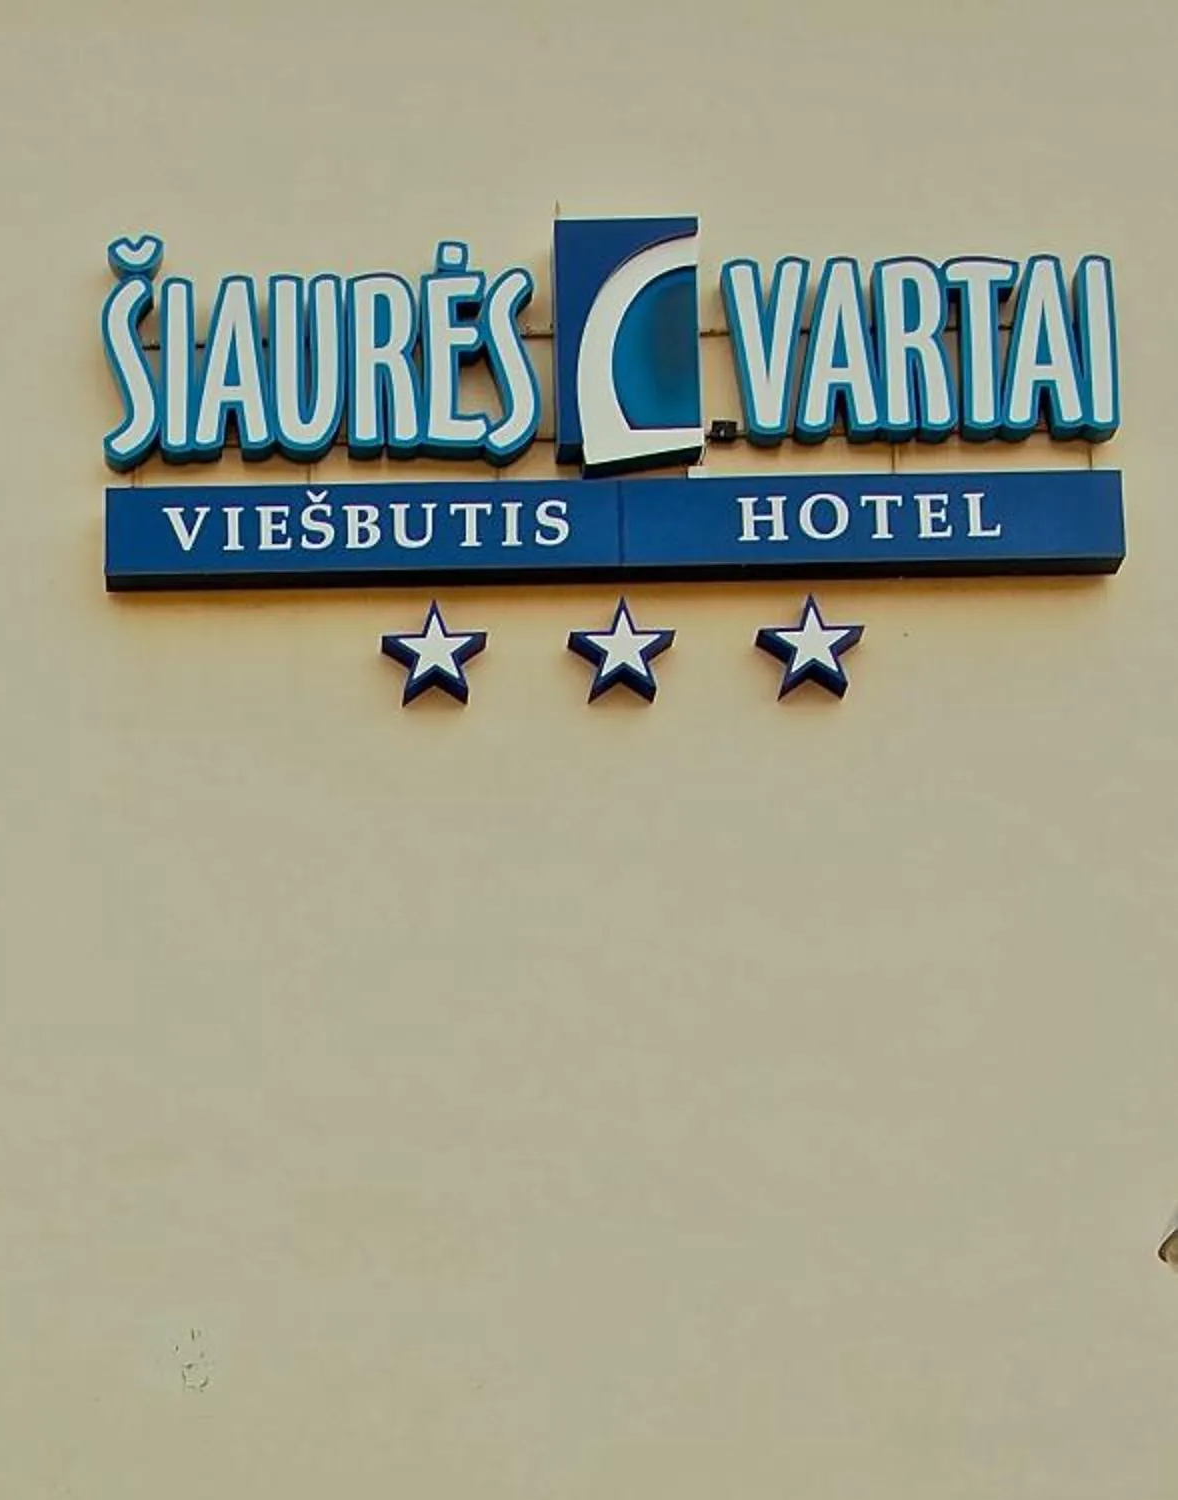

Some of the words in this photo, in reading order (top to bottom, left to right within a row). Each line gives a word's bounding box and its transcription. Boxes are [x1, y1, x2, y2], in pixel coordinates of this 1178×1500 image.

[102, 235, 540, 470] ŠIAURĖS
[718, 254, 1119, 444] VARTAI
[162, 490, 572, 554] VIEŠBUTIS
[736, 492, 1004, 544] HOTEL
